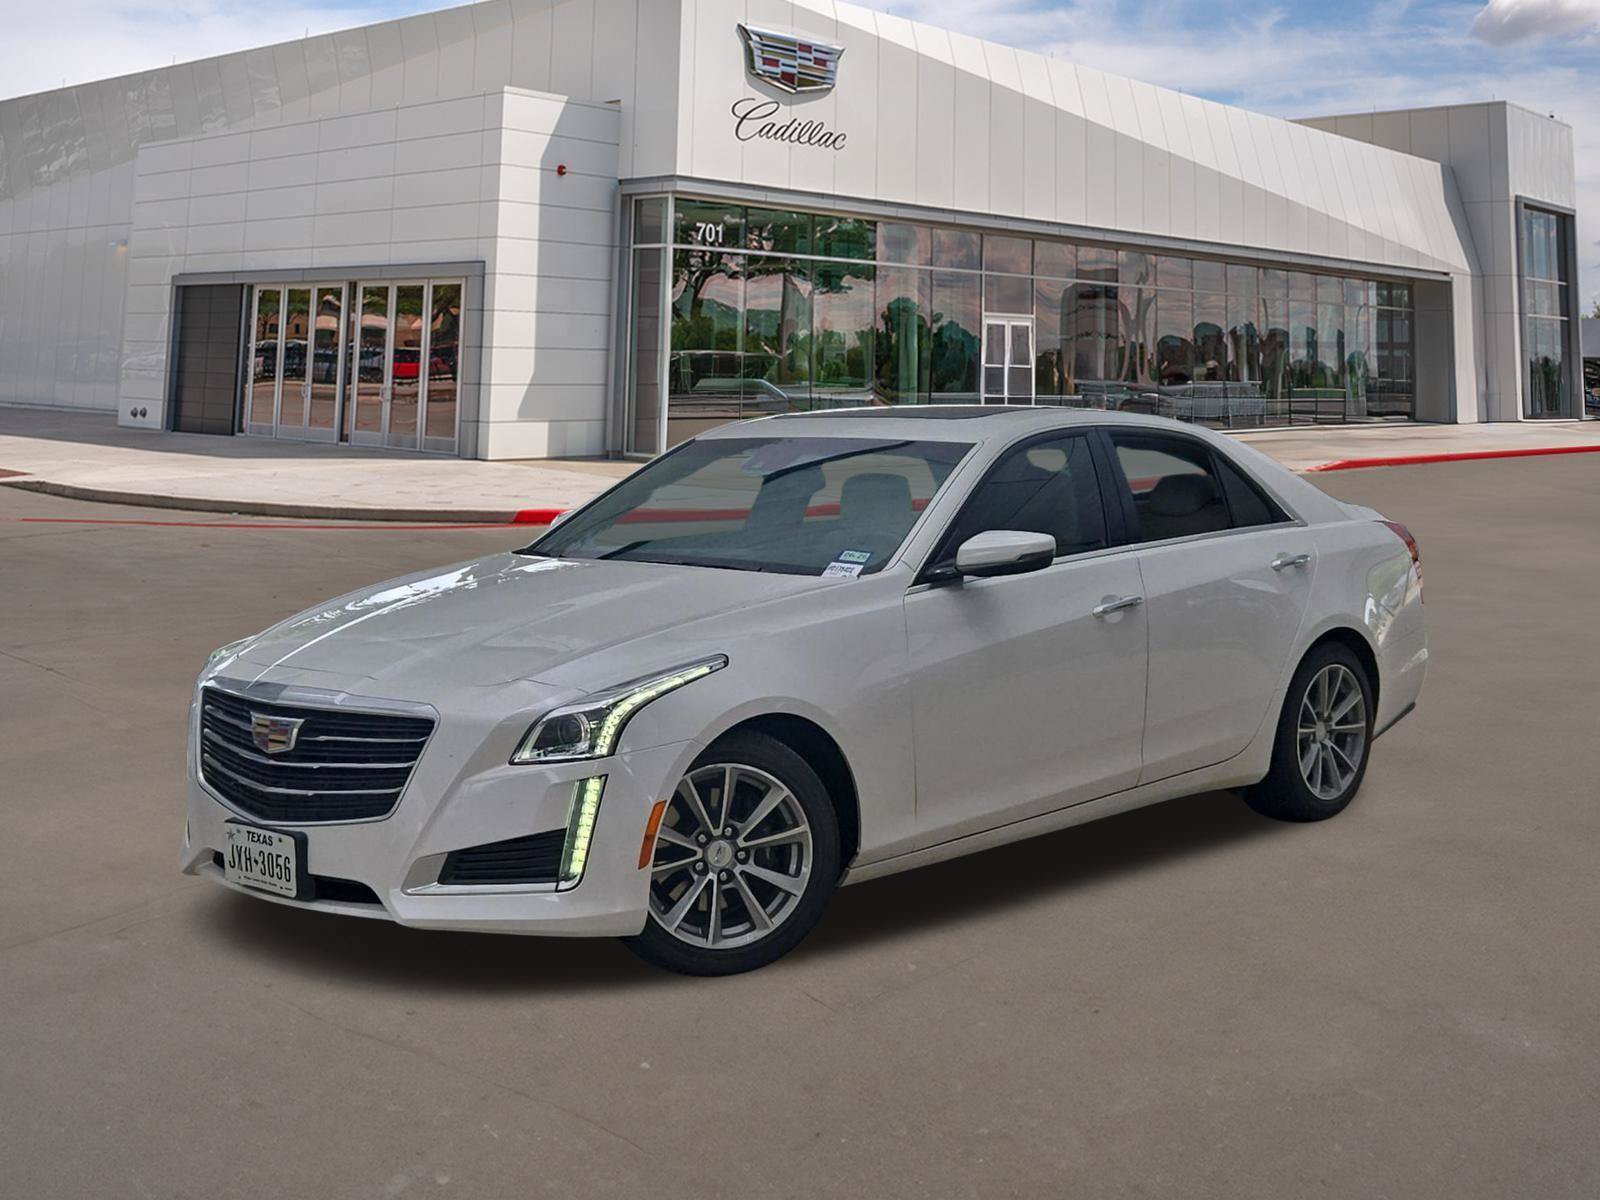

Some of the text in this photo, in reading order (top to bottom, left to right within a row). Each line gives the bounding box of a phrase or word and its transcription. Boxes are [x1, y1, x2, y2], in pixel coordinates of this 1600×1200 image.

[731, 98, 847, 150] Cadillac
[696, 222, 724, 243] 701
[246, 830, 274, 847] TEXAS
